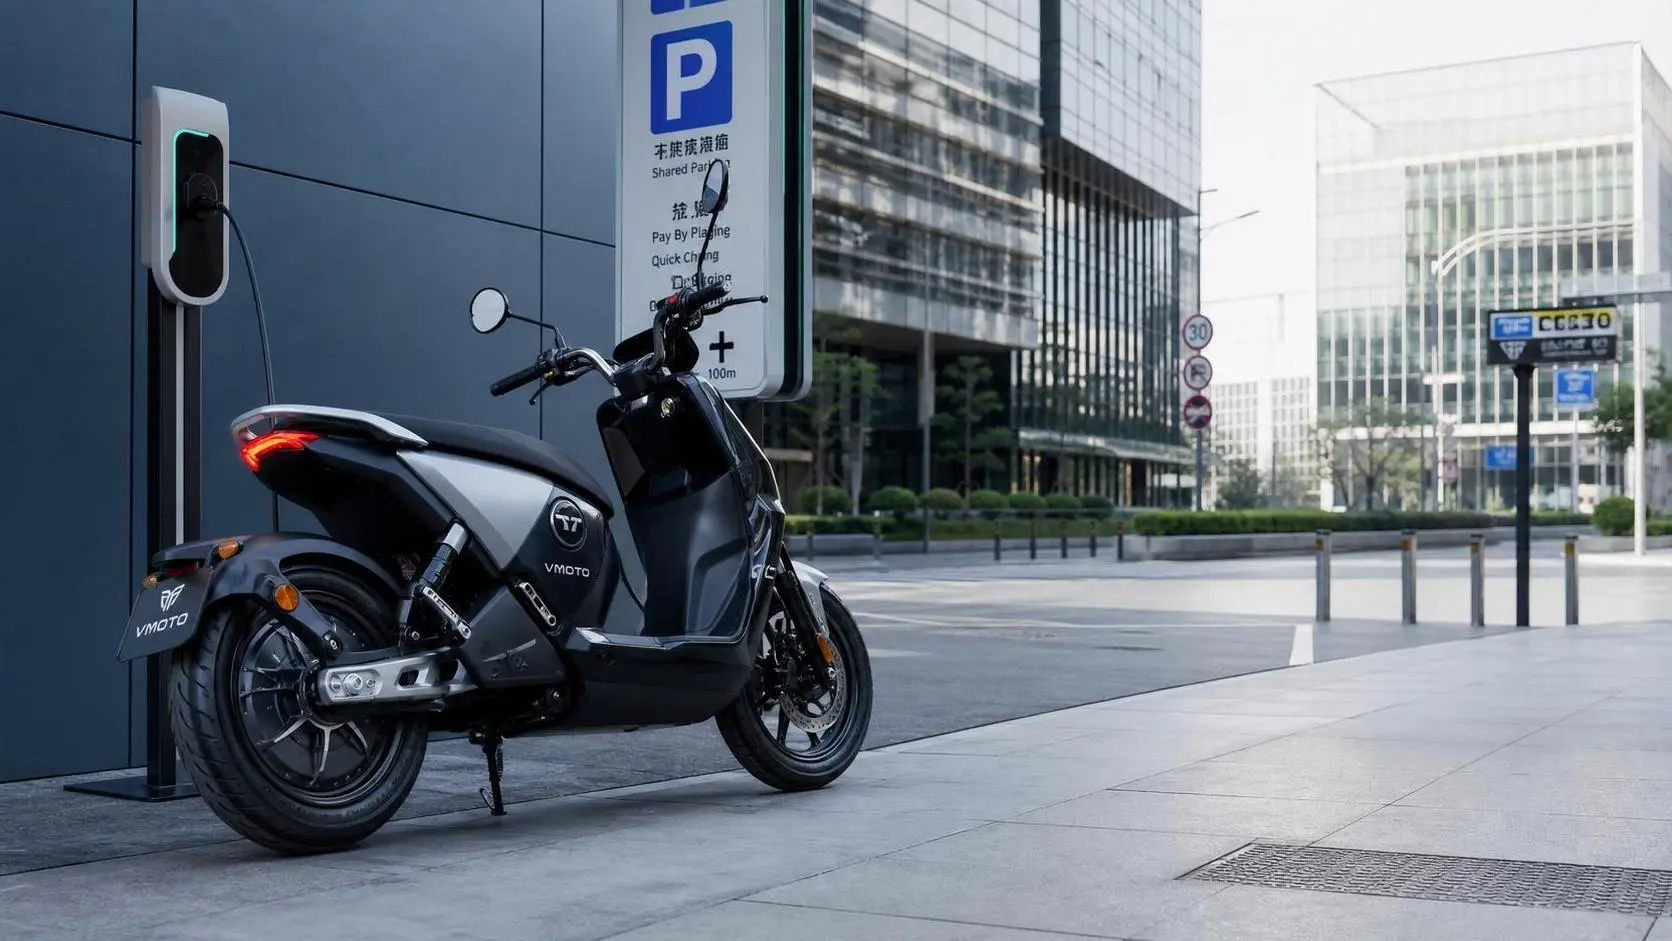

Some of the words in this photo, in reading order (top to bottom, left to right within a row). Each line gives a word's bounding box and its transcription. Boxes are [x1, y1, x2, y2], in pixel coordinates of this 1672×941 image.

[667, 38, 717, 120] P
[652, 163, 688, 179] Shared
[652, 232, 672, 245] Pay
[674, 229, 688, 243] By
[651, 253, 681, 268] Quick
[1188, 323, 1208, 341] 30
[708, 368, 737, 379] 100m
[544, 562, 590, 577] VMOTO
[136, 612, 189, 638] VMOTO
